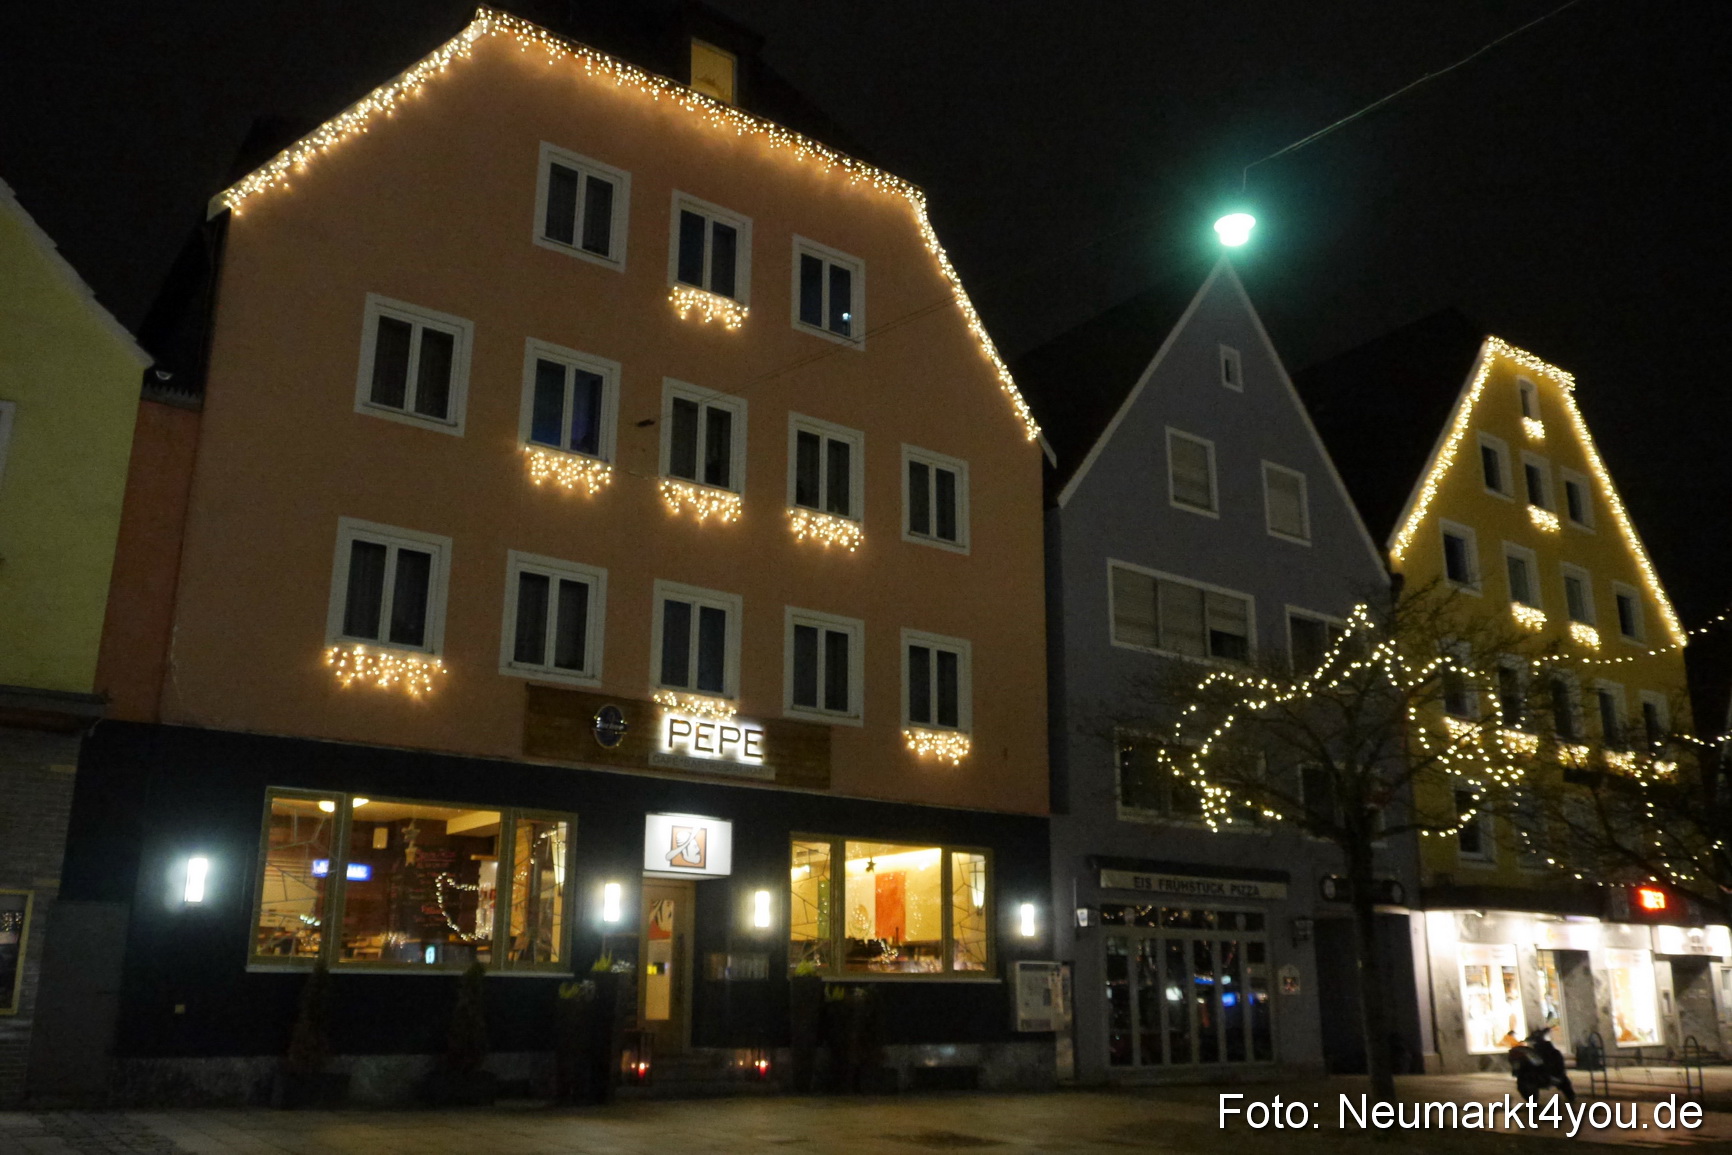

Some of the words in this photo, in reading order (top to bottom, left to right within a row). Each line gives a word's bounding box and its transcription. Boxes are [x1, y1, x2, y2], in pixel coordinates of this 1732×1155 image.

[668, 718, 764, 759] PEPE
[1133, 876, 1152, 890] EIS
[1230, 883, 1260, 896] PIZZA
